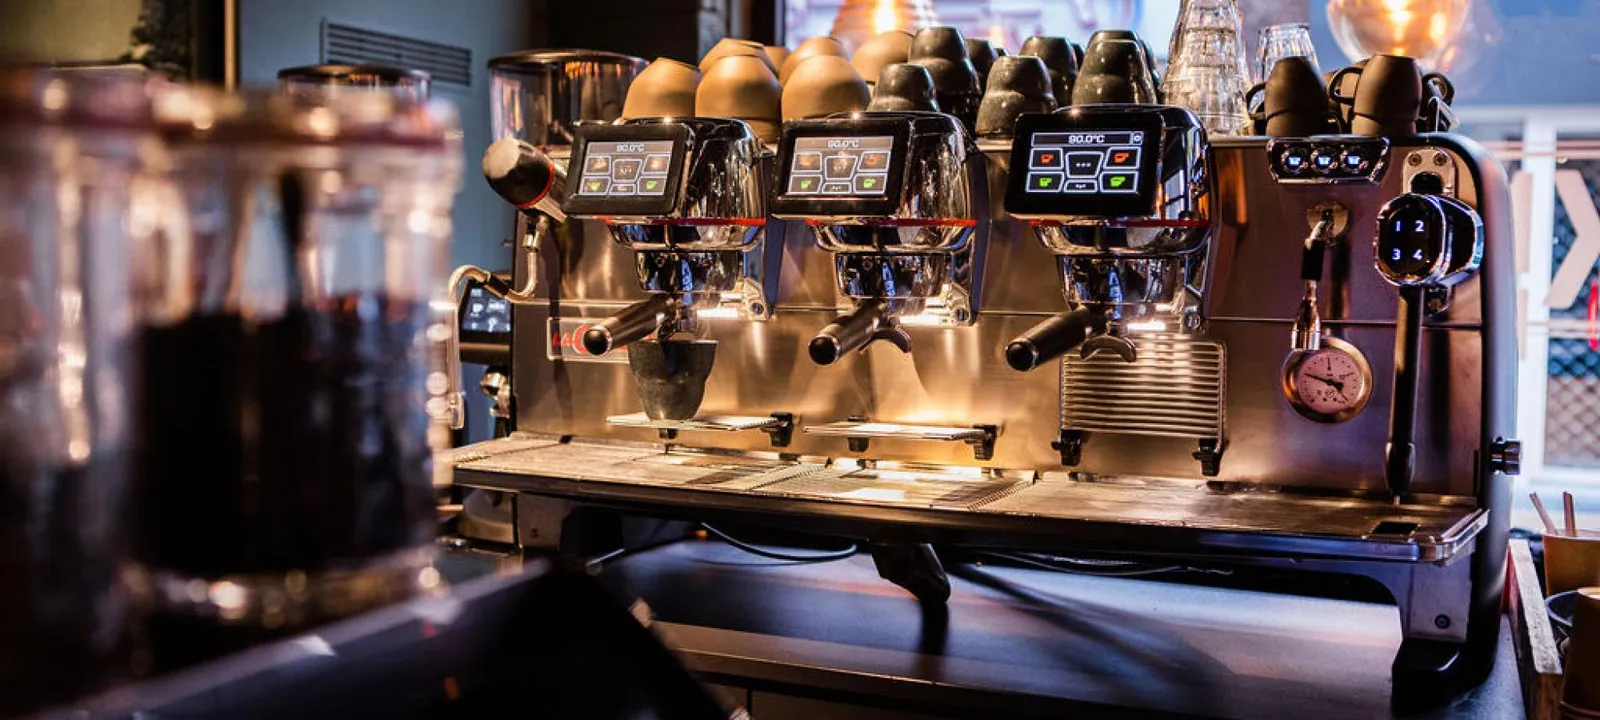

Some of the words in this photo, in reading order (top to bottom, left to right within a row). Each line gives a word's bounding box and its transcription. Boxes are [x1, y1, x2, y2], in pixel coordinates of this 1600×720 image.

[1068, 134, 1105, 144] 90.0°C
[1396, 221, 1401, 232] 1
[1415, 220, 1424, 232] 2
[1392, 248, 1401, 260] 3
[1413, 249, 1423, 260] 4
